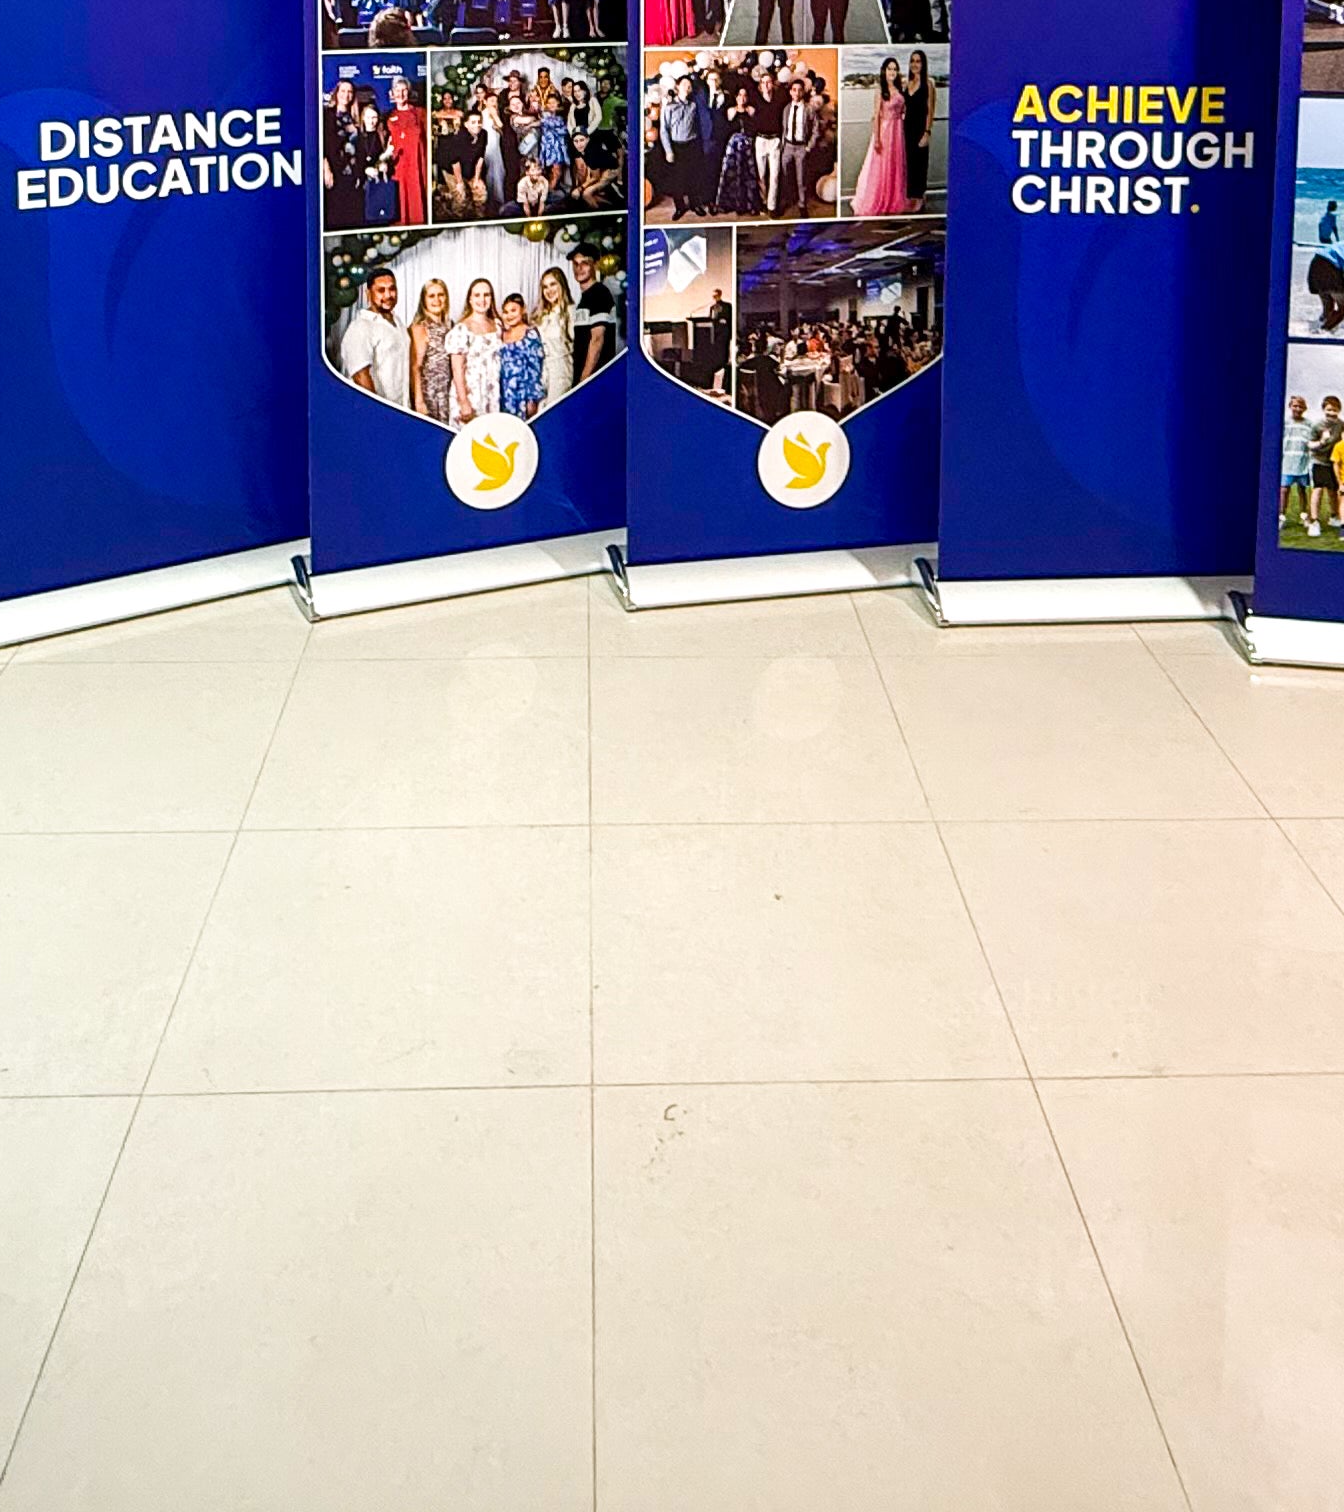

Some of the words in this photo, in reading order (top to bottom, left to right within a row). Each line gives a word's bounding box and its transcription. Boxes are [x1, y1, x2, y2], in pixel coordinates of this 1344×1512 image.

[1012, 85, 1226, 124] ACHIEVE
[39, 107, 282, 162] DISTANCE
[1011, 129, 1254, 170] THROUGH
[17, 149, 302, 210] EDUCATION
[1011, 175, 1201, 215] CHRIST.
